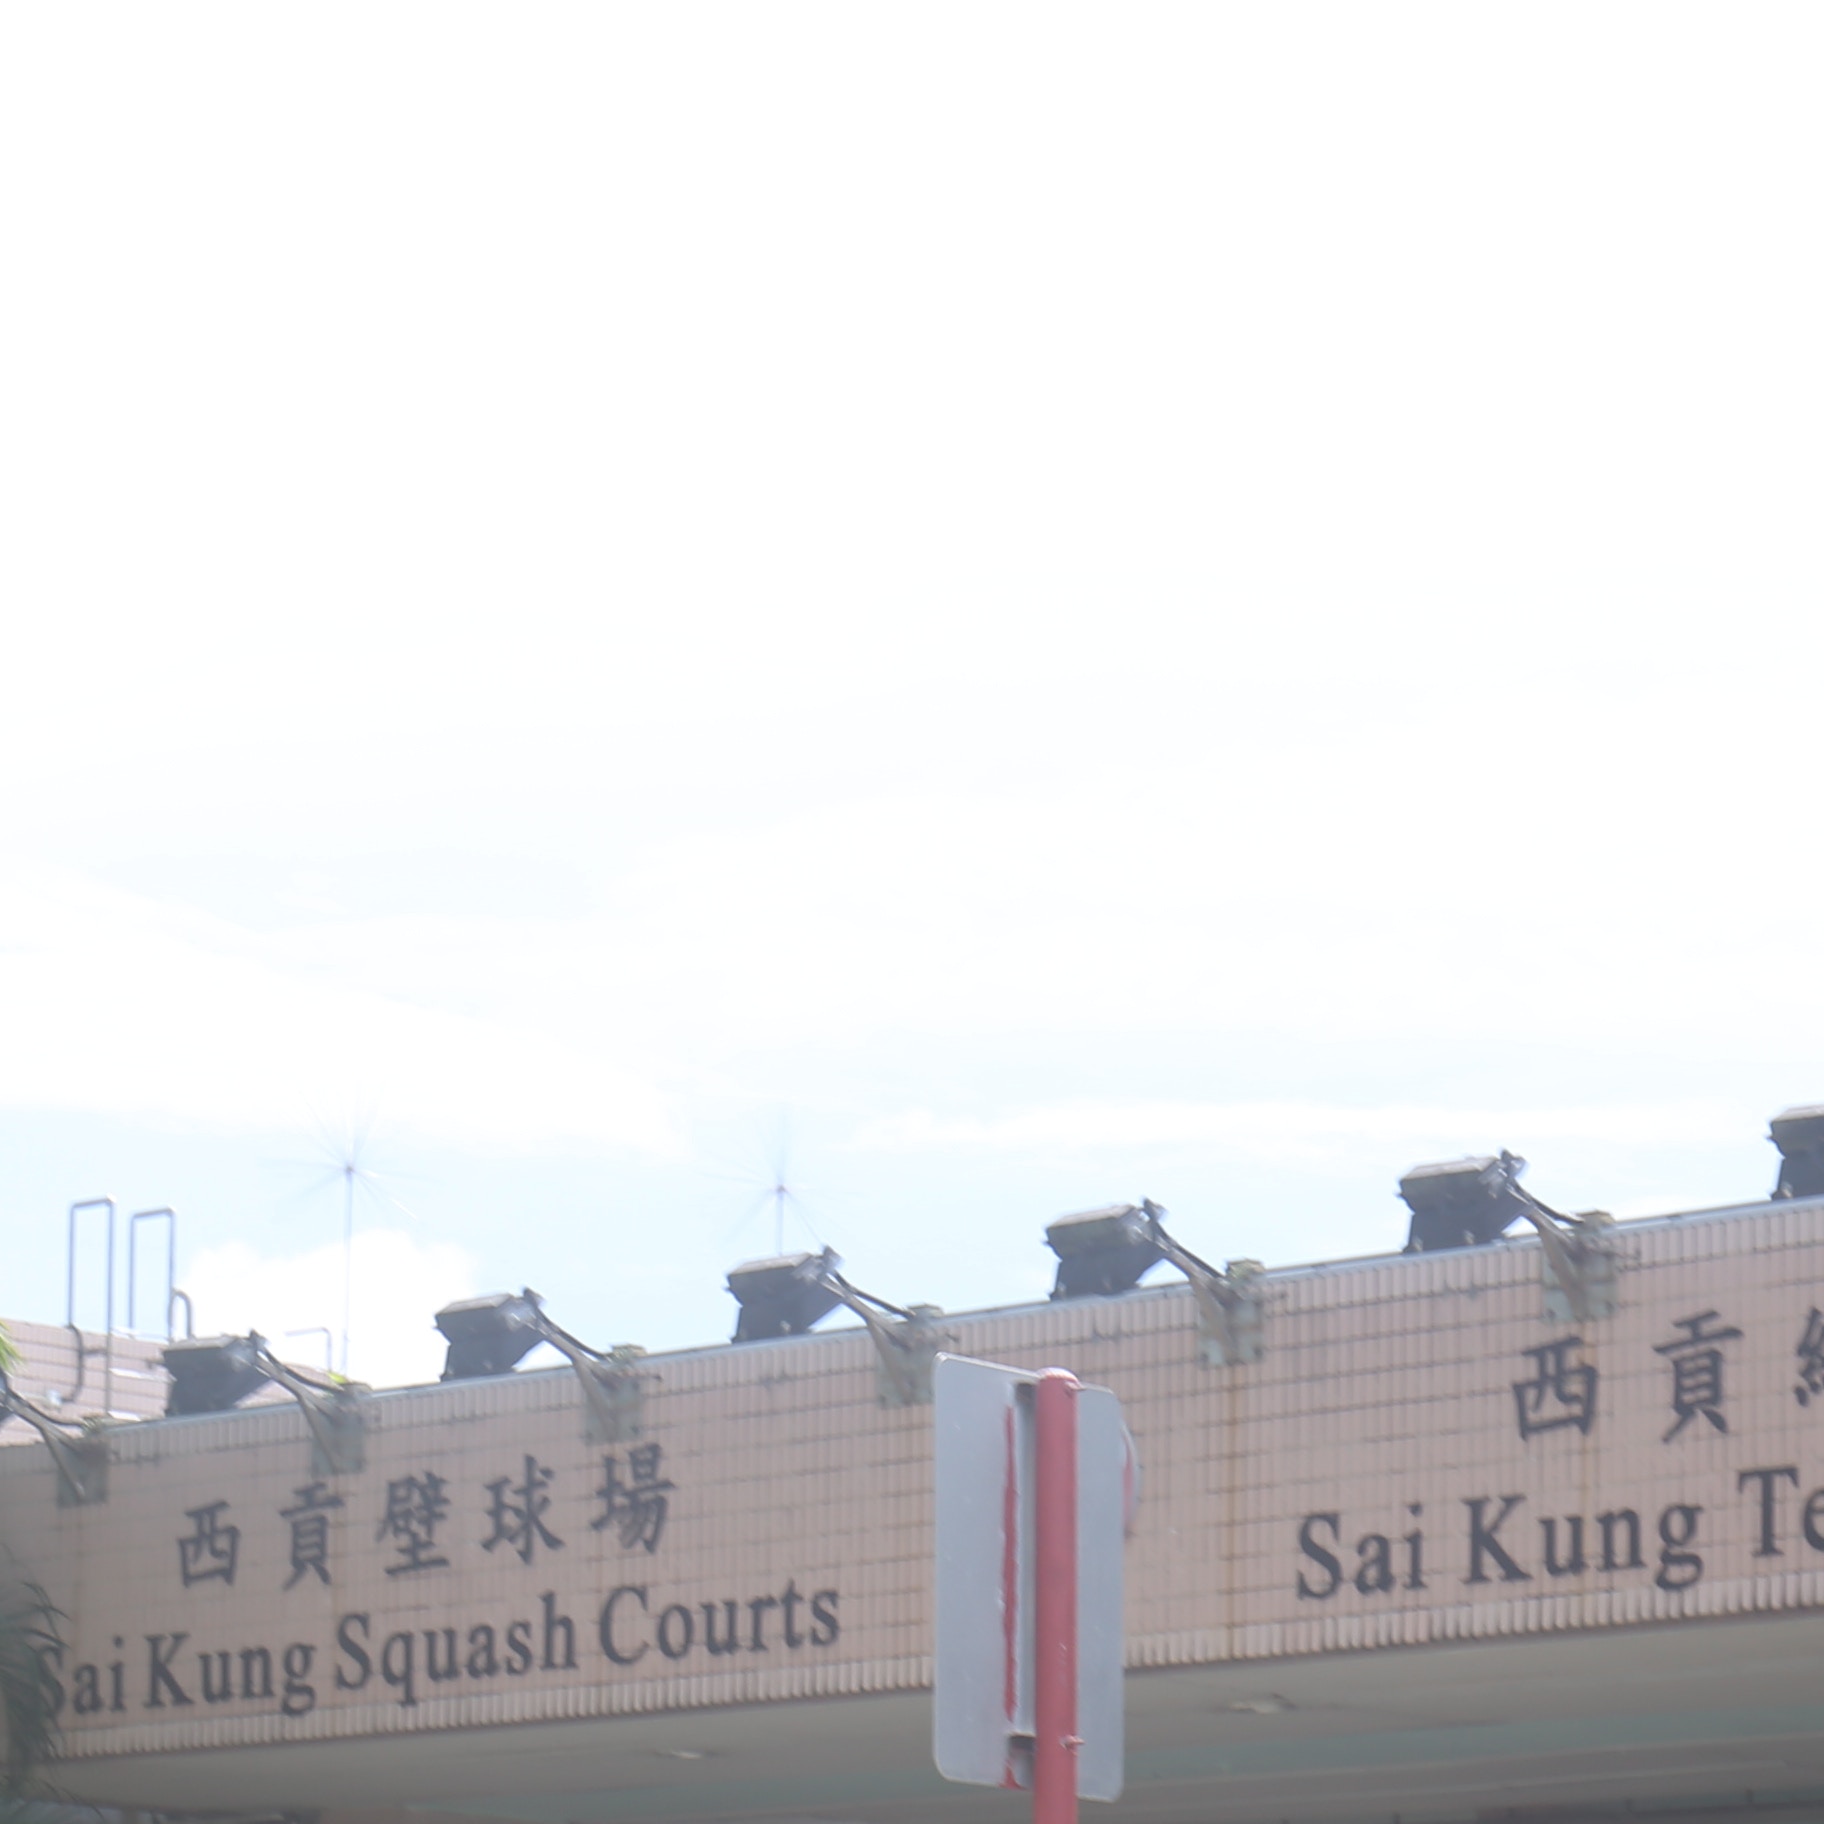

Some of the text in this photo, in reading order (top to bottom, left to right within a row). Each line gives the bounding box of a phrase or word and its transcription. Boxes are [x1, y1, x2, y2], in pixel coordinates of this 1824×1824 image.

[176, 1441, 678, 1592] 西貢壁球場
[1295, 1500, 1427, 1602] Sai
[1461, 1494, 1706, 1592] Kung
[142, 1631, 318, 1718] Kung
[334, 1588, 578, 1710] Squash
[597, 1578, 843, 1667] Courts
